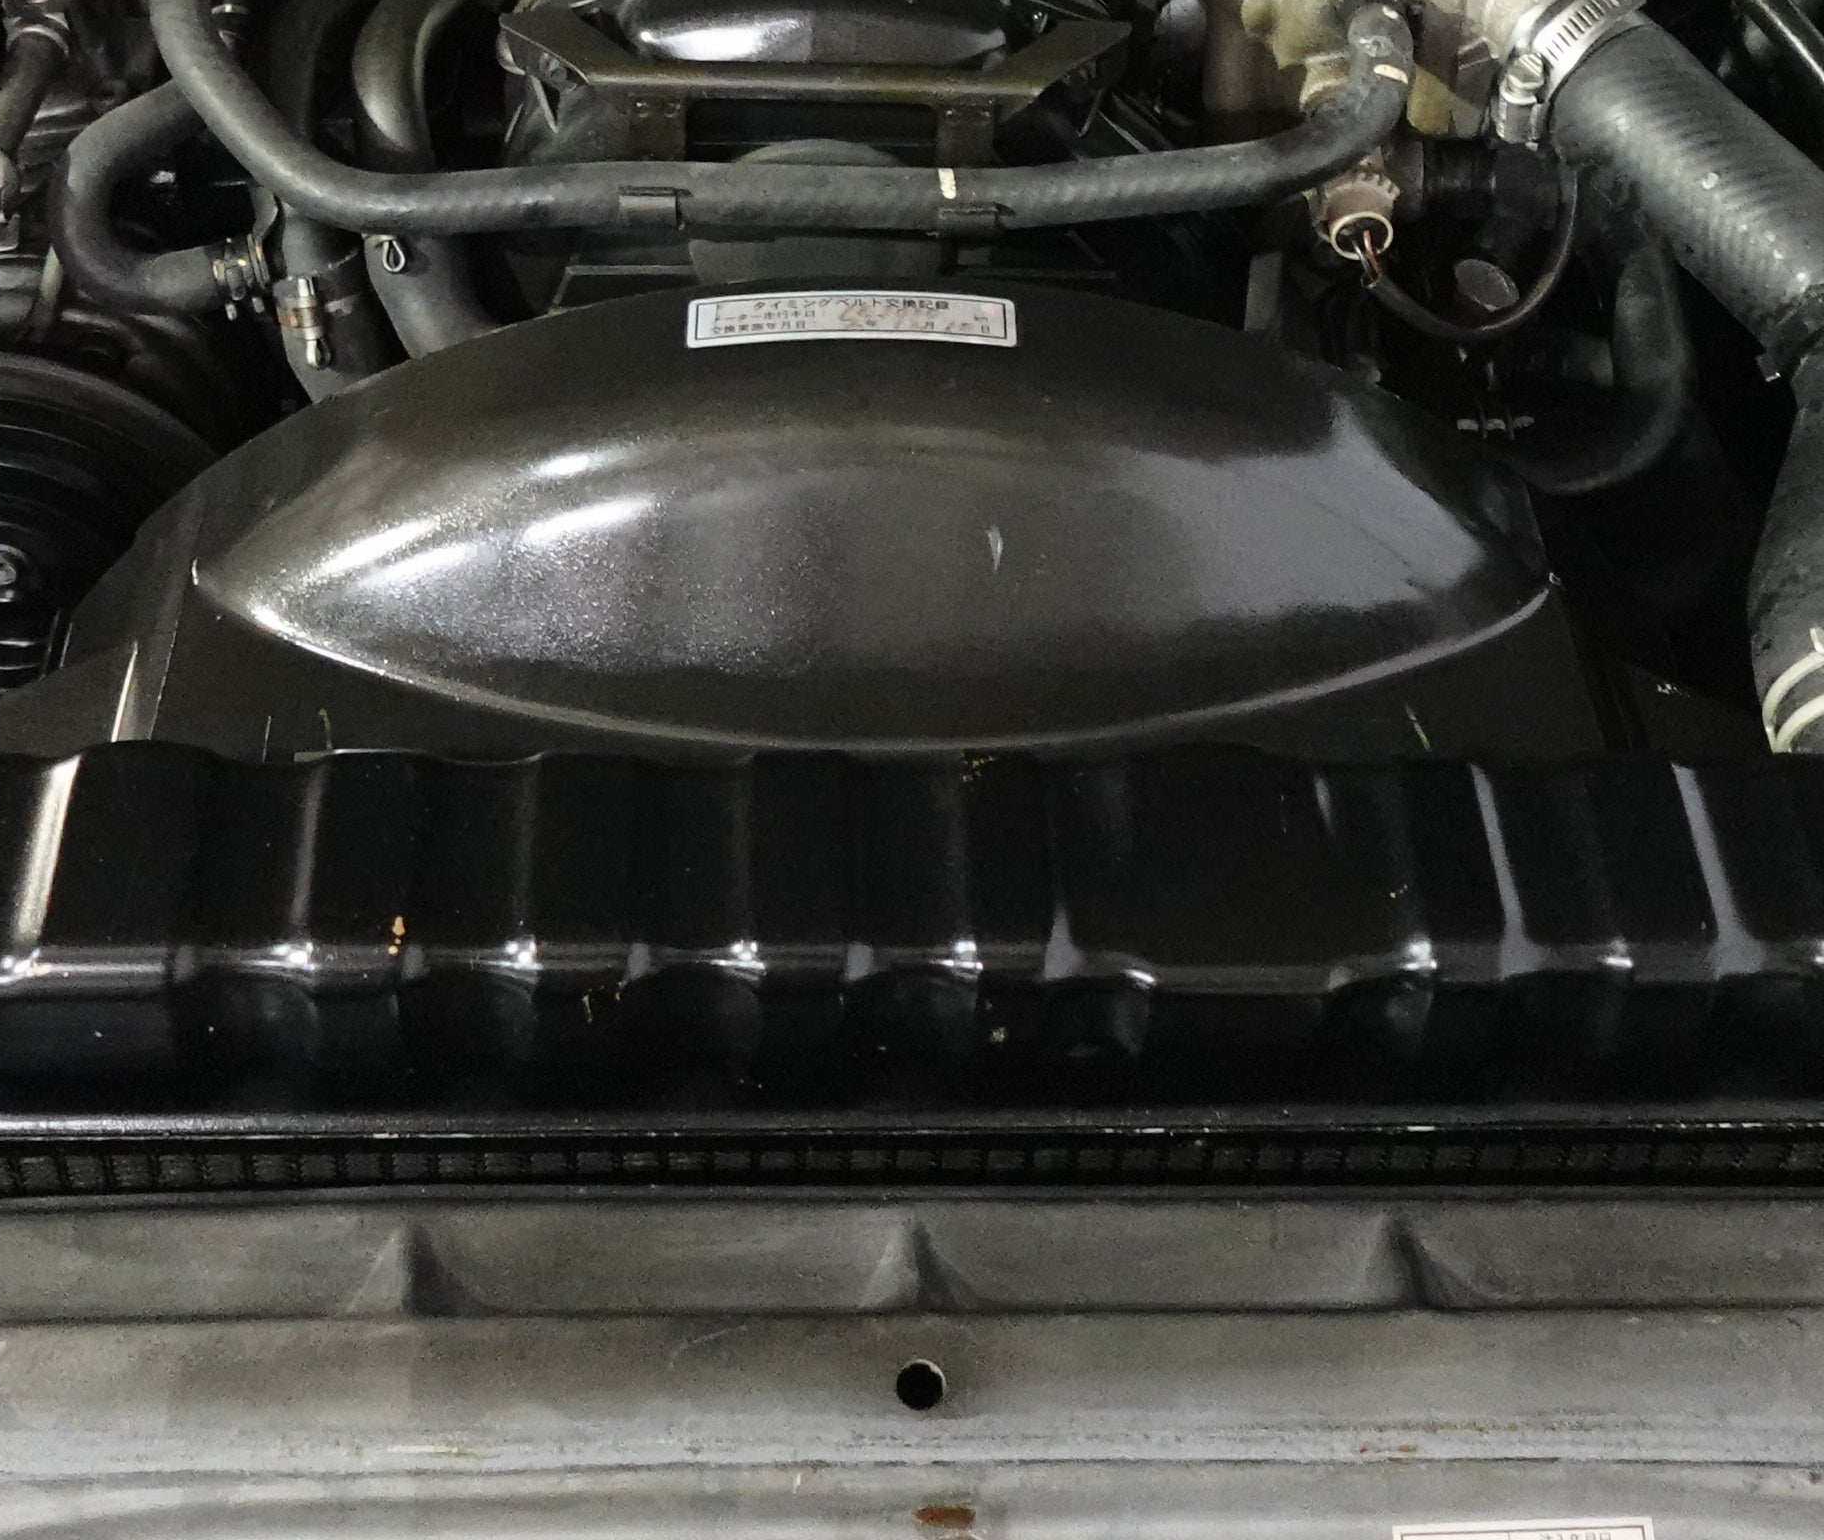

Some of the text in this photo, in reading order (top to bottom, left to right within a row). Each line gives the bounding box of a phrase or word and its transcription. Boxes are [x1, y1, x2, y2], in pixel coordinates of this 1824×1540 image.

[753, 297, 951, 311] タイミングベルト交換記録
